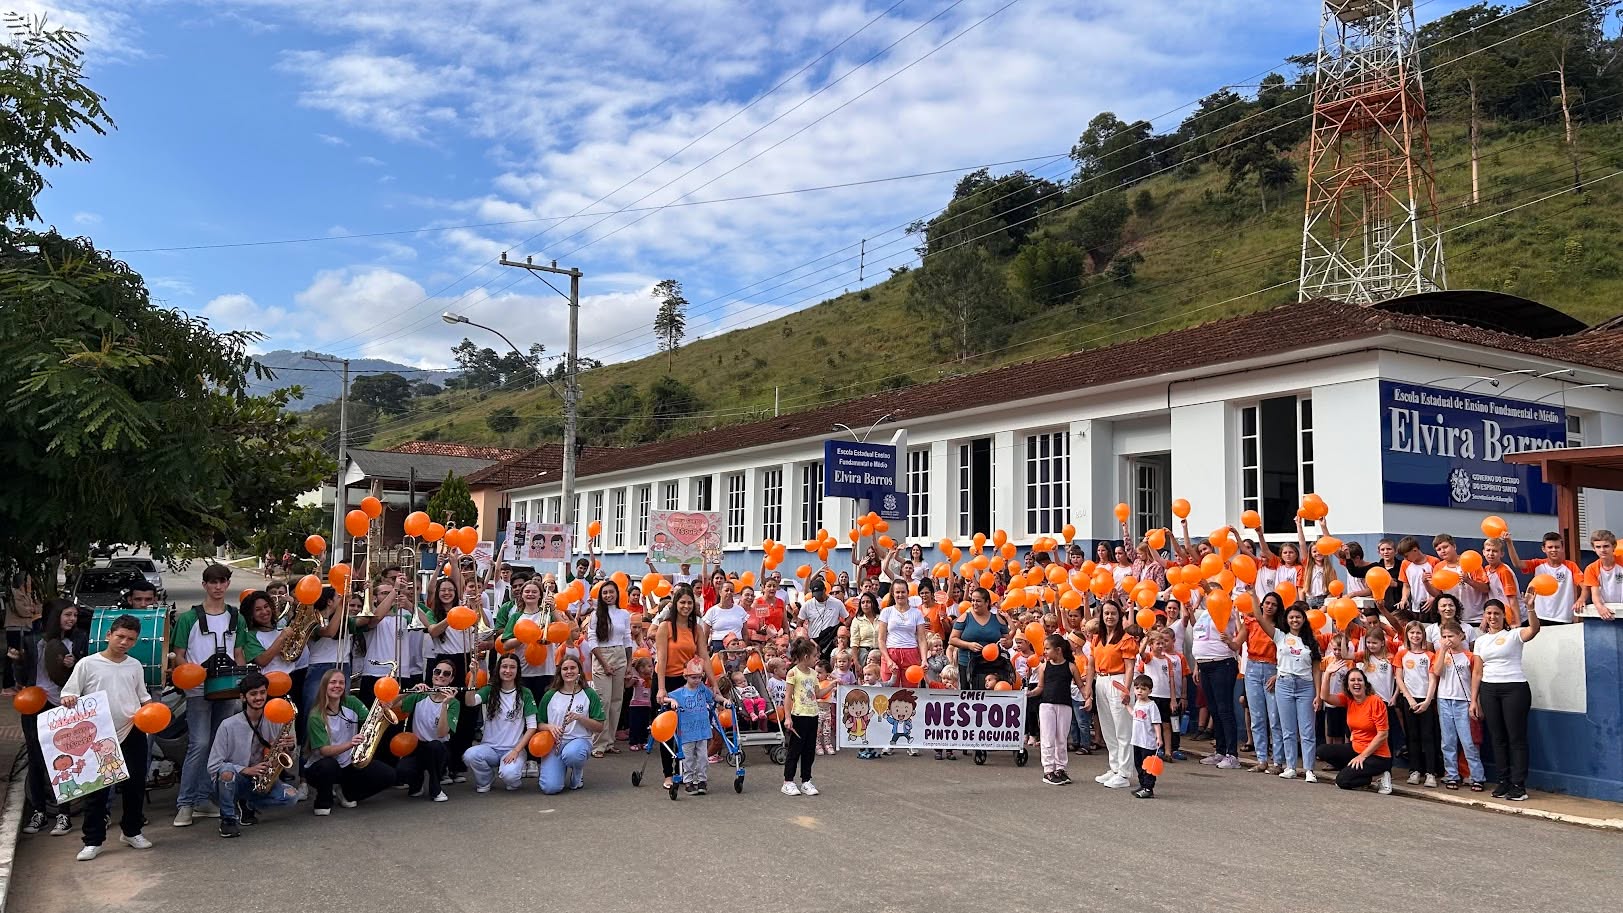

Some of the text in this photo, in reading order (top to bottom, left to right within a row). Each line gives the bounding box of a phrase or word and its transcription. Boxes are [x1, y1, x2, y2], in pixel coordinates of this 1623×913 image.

[1394, 388, 1559, 424] Escola Estadual de Ensino Fundamental e Médio
[1388, 406, 1565, 462] Elvira Barr
[836, 448, 853, 456] Escola
[854, 450, 874, 458] Estadual
[839, 458, 869, 467] Fundamental
[834, 469, 893, 486] Elvira Barros
[1471, 474, 1495, 483] GOVERNO
[1502, 476, 1520, 485] ESTADO
[1472, 482, 1518, 494] DO ESPÍRITO SANTO
[959, 690, 986, 702] CMEI
[924, 701, 1021, 728] NESTOR
[924, 728, 1020, 742] PINTO DE AGUIAR
